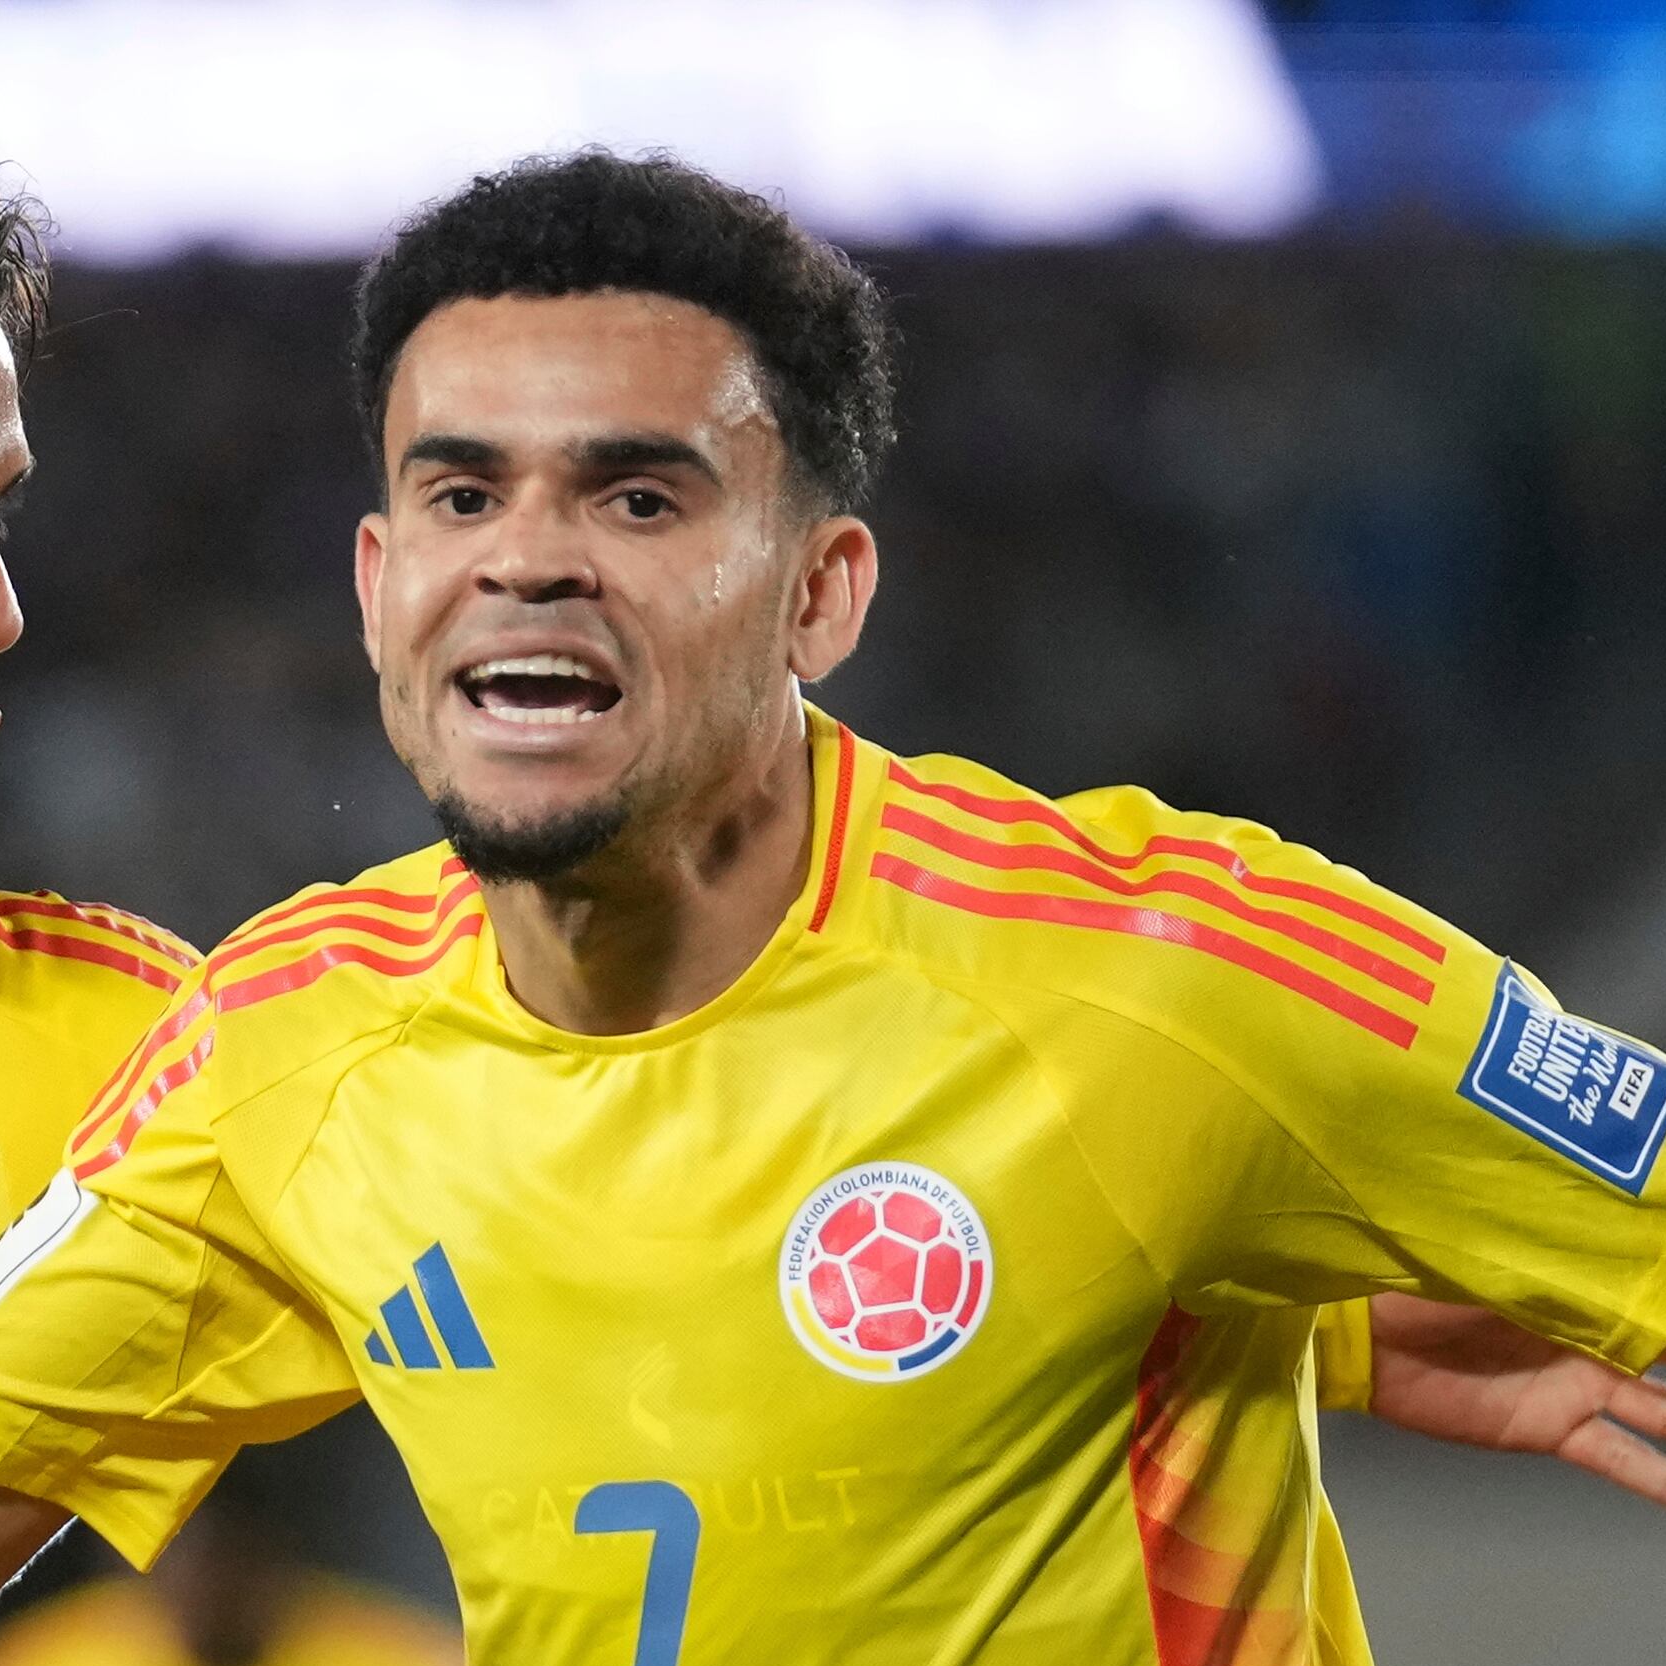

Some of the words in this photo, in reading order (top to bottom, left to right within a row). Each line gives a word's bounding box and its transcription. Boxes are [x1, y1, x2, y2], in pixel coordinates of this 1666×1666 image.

[1507, 1009, 1555, 1085] FOOTBA
[1532, 1015, 1591, 1103] UNITE
[1567, 1084, 1601, 1126] the
[1619, 1066, 1647, 1108] FIFA
[788, 1192, 834, 1282] FEDERACION
[833, 1170, 930, 1200] COLOMBIANA
[930, 1185, 950, 1205] DE
[945, 1199, 982, 1256] FUTBOL
